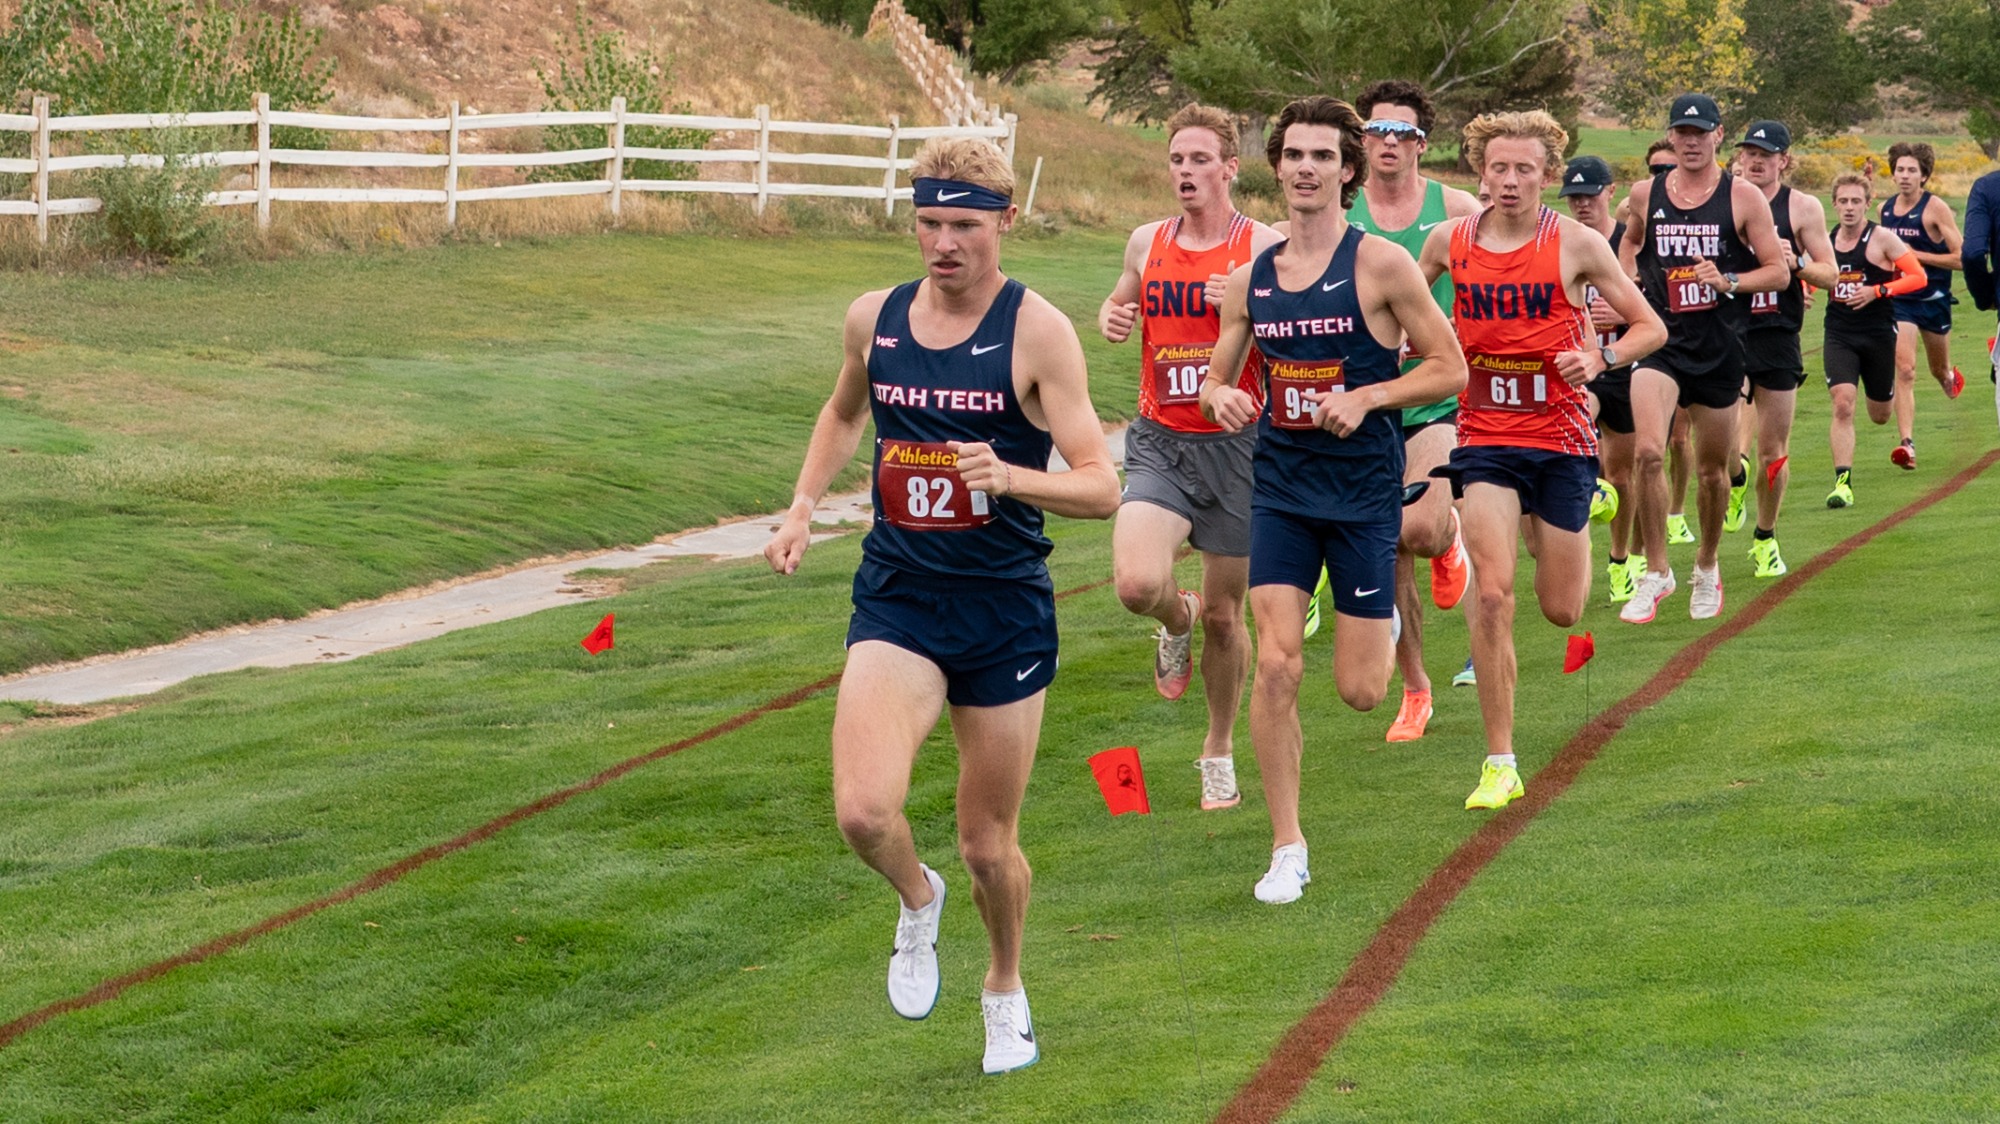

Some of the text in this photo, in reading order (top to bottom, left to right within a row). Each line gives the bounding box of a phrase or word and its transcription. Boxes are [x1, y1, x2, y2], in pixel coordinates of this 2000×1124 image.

[1655, 224, 1719, 236] SOUTHERN
[1656, 236, 1719, 257] UTAH
[1146, 280, 1220, 318] SNO
[1455, 282, 1555, 321] SNOW
[1254, 321, 1293, 338] UTAH
[1296, 316, 1353, 335] TECH
[876, 335, 898, 348] WAC
[873, 382, 927, 408] UTAH
[933, 389, 1004, 412] TECH
[1490, 376, 1521, 405] 61
[907, 476, 955, 518] 82
